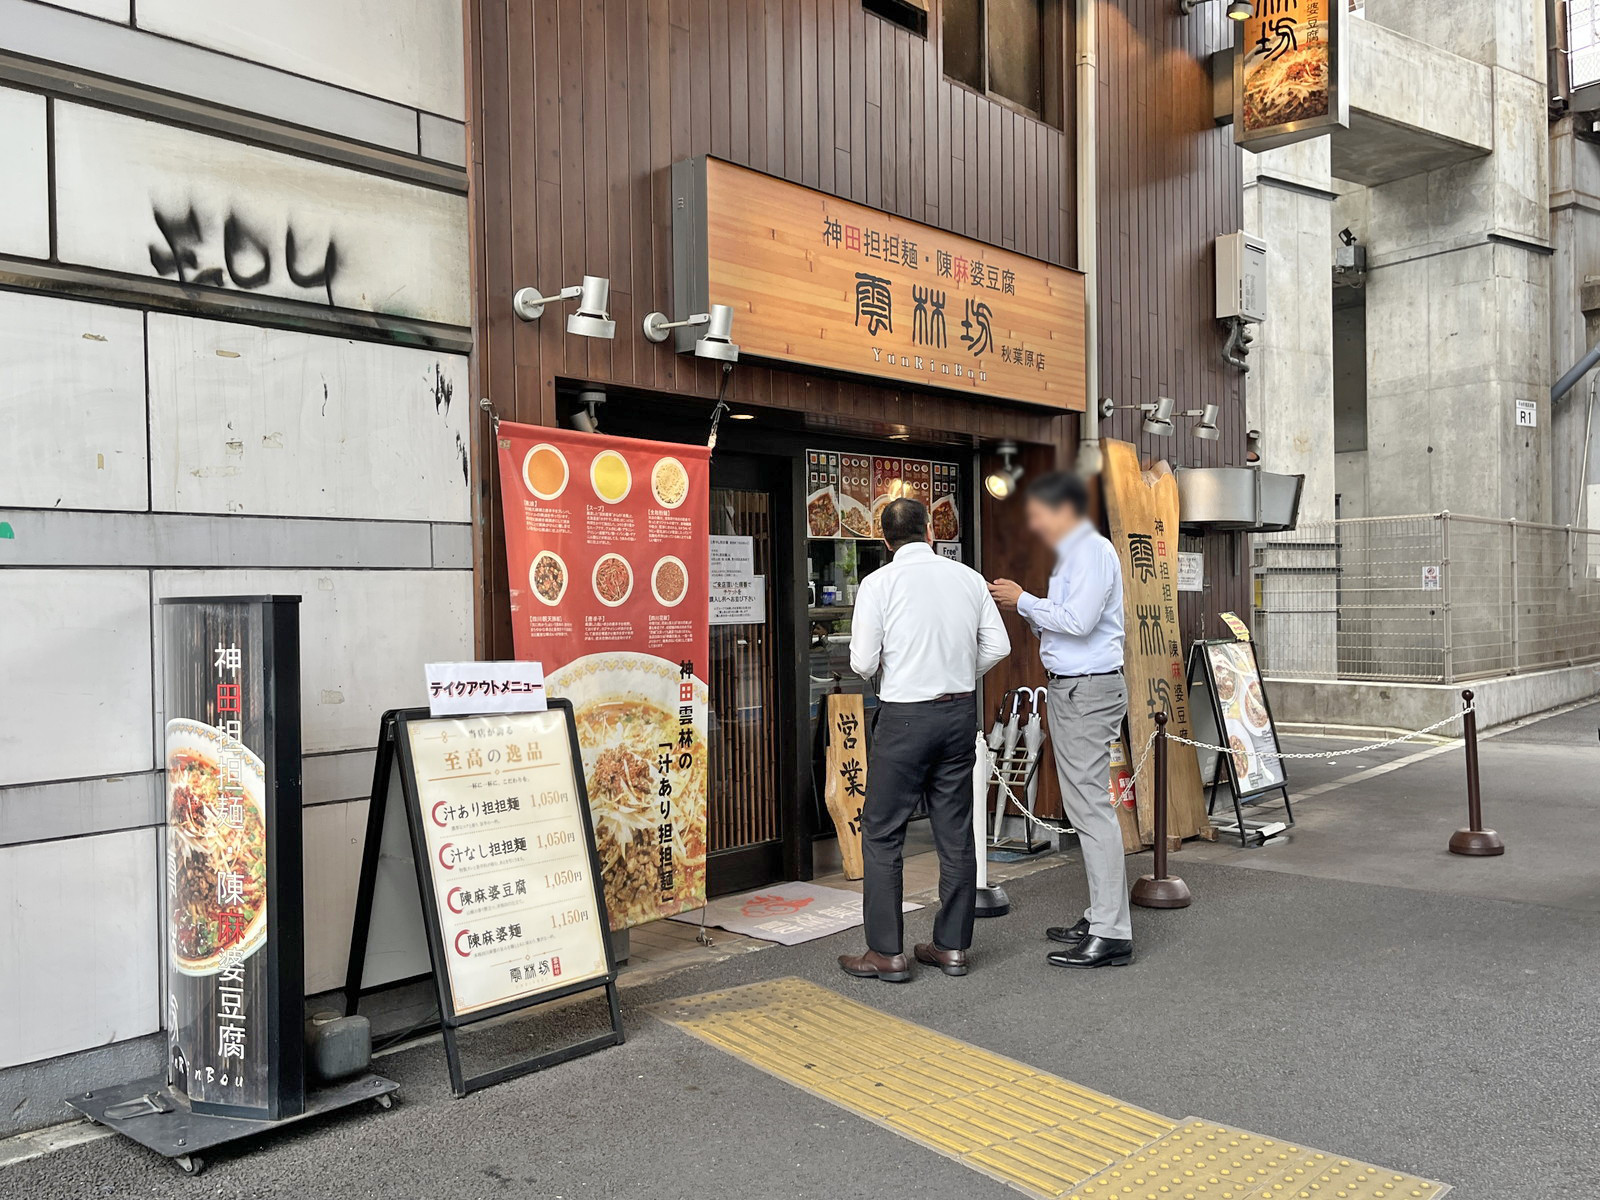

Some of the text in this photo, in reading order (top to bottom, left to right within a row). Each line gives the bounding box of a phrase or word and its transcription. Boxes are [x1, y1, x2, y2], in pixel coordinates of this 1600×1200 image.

[872, 347, 987, 381] YunRinBou
[1001, 345, 1046, 372] 秋葉原店
[1520, 410, 1531, 424] R1
[943, 547, 957, 556] Free
[430, 680, 543, 697] テイクアウトメニュー
[678, 660, 694, 769] 神田雲林の
[444, 741, 543, 771] 至高の逸品
[444, 790, 569, 821] 汁あり担担麺 1,050円
[658, 742, 674, 903] 「汁あり担担麺」
[450, 830, 576, 864] 汁なし担担麺 1,050円
[459, 878, 527, 907] 陳麻婆豆腐
[544, 869, 583, 889] 1,050円
[467, 923, 523, 950] 陳麻婆麺
[551, 909, 589, 929] 1,150円
